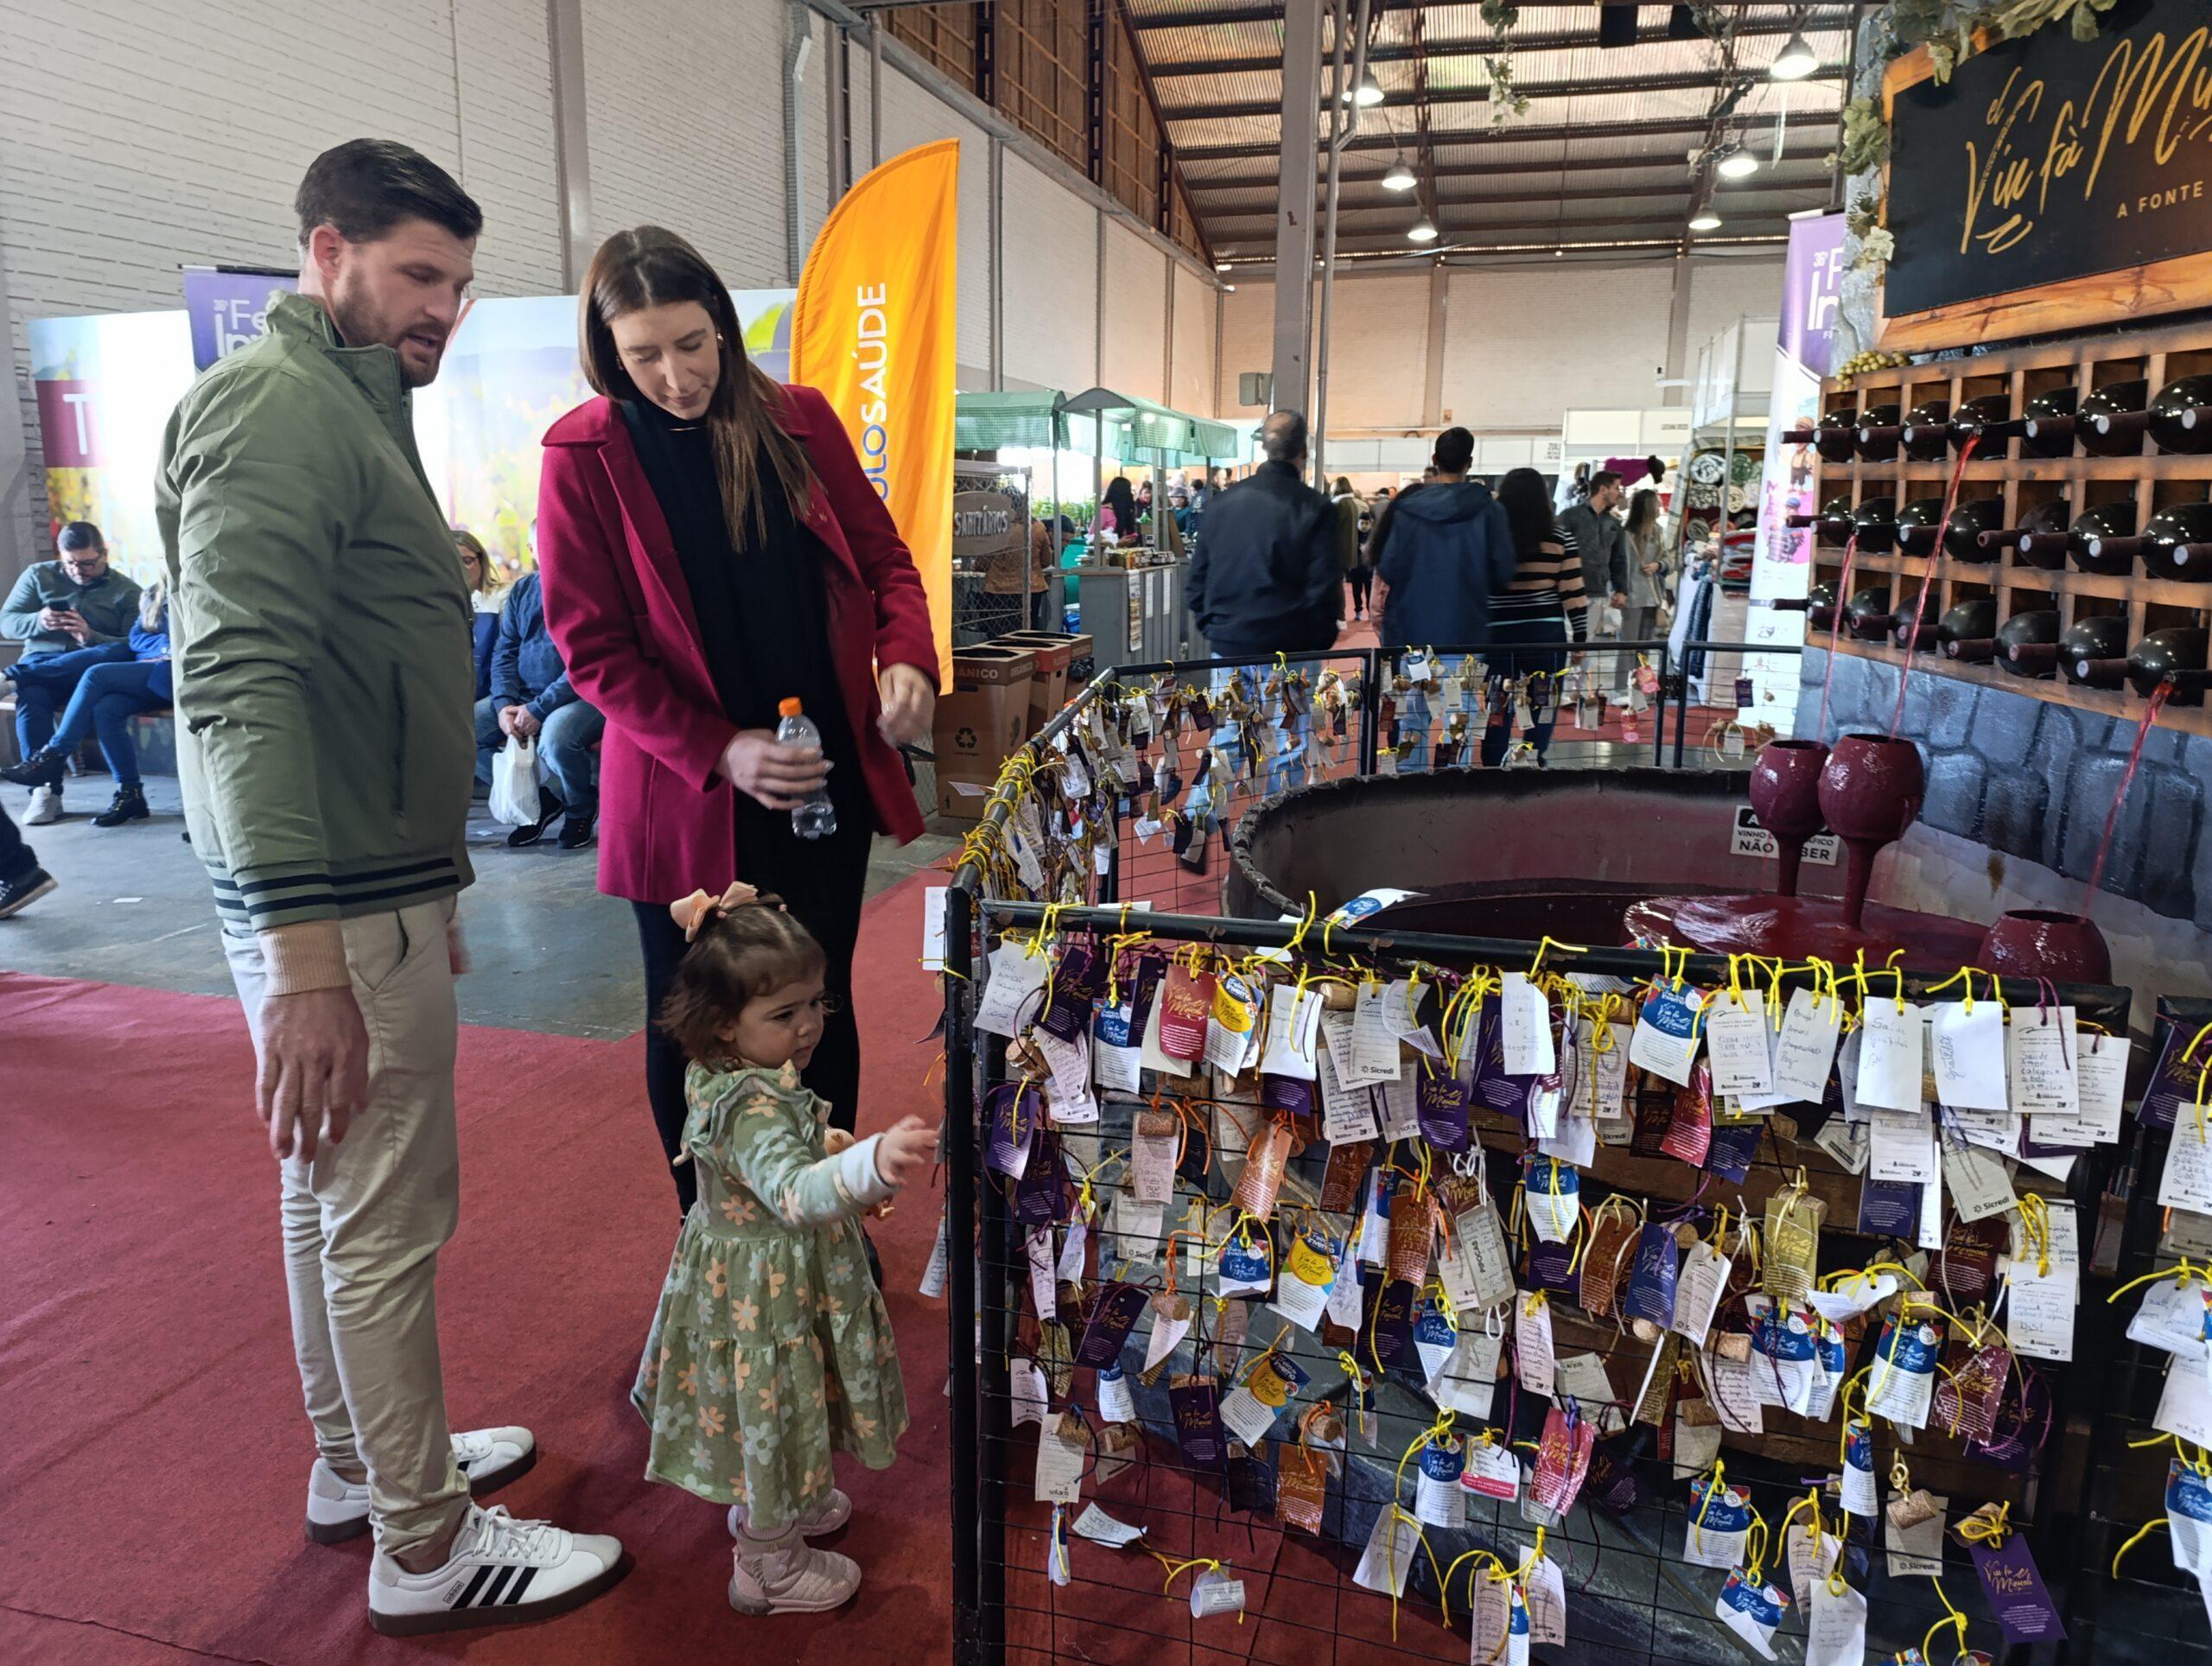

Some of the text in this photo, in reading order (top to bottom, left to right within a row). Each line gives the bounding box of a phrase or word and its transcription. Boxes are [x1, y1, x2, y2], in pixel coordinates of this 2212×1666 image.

[2116, 180, 2204, 219] A FONTE
[1738, 829, 1766, 839] VINHO
[1738, 837, 1774, 854] NÃO
[1370, 1065, 1395, 1075] Sicredi
[1982, 1195, 2010, 1211] Sicredi
